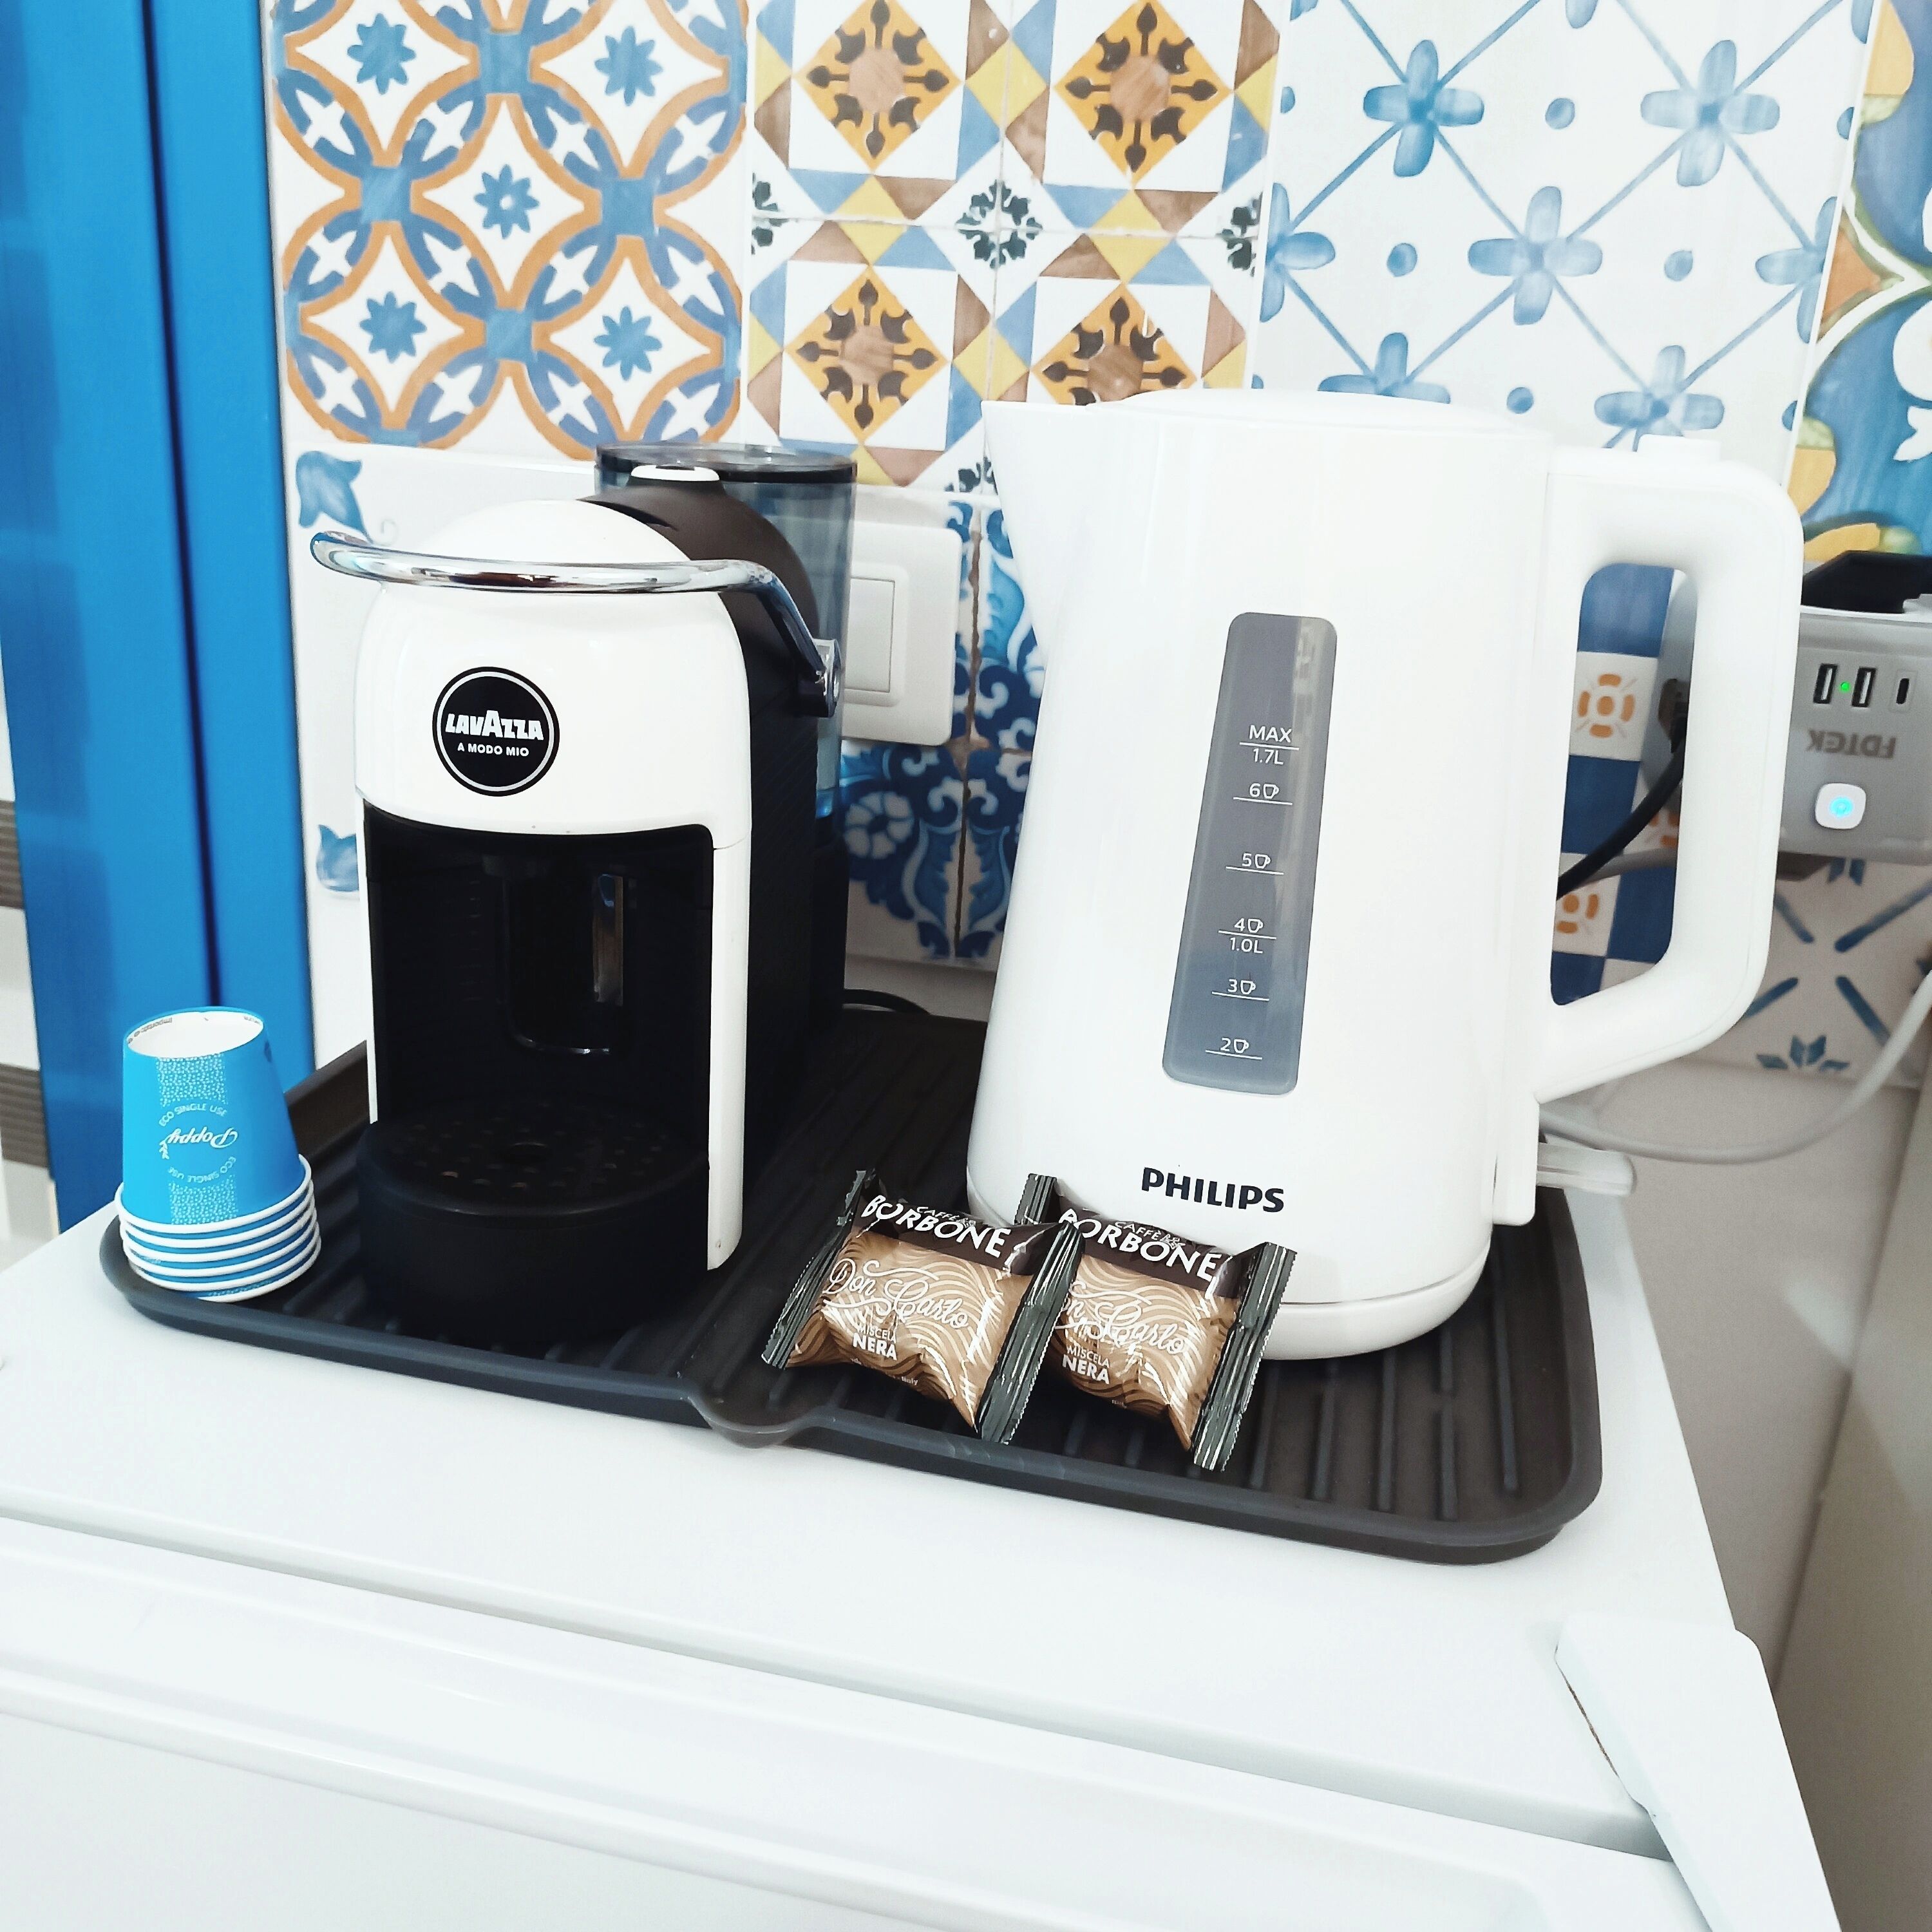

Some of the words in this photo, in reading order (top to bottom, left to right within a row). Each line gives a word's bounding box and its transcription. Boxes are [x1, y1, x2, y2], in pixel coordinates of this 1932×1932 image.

[445, 710, 544, 741] LAVAZZA
[1249, 724, 1292, 743] MAX
[457, 742, 466, 752] A
[468, 743, 503, 755] MODO
[506, 746, 529, 757] MIO
[1253, 748, 1284, 765] 1.7L
[1249, 782, 1261, 797] 6
[1242, 853, 1252, 867] 5
[1234, 918, 1245, 931] 4
[1230, 937, 1264, 954] 1.0L
[1227, 978, 1238, 992] 3
[1220, 1037, 1231, 1052] 2
[158, 1111, 175, 1126] ECO
[174, 1103, 207, 1115] SINGLE
[209, 1104, 227, 1117] USE
[166, 1126, 238, 1149] Poppy
[169, 1166, 185, 1180] USE
[220, 1156, 237, 1174] ECO
[187, 1171, 220, 1184] SINGLE
[1141, 1167, 1284, 1213] PHILIPS
[861, 1195, 1011, 1258] BORBONE
[822, 1258, 877, 1294] Don
[884, 1278, 969, 1329] Carlo
[857, 1322, 897, 1345] MISCELA
[1094, 1300, 1186, 1354] Carlo
[853, 1332, 897, 1361] NERA
[1066, 1344, 1110, 1368] MISCELA
[1062, 1354, 1110, 1385] NERA
